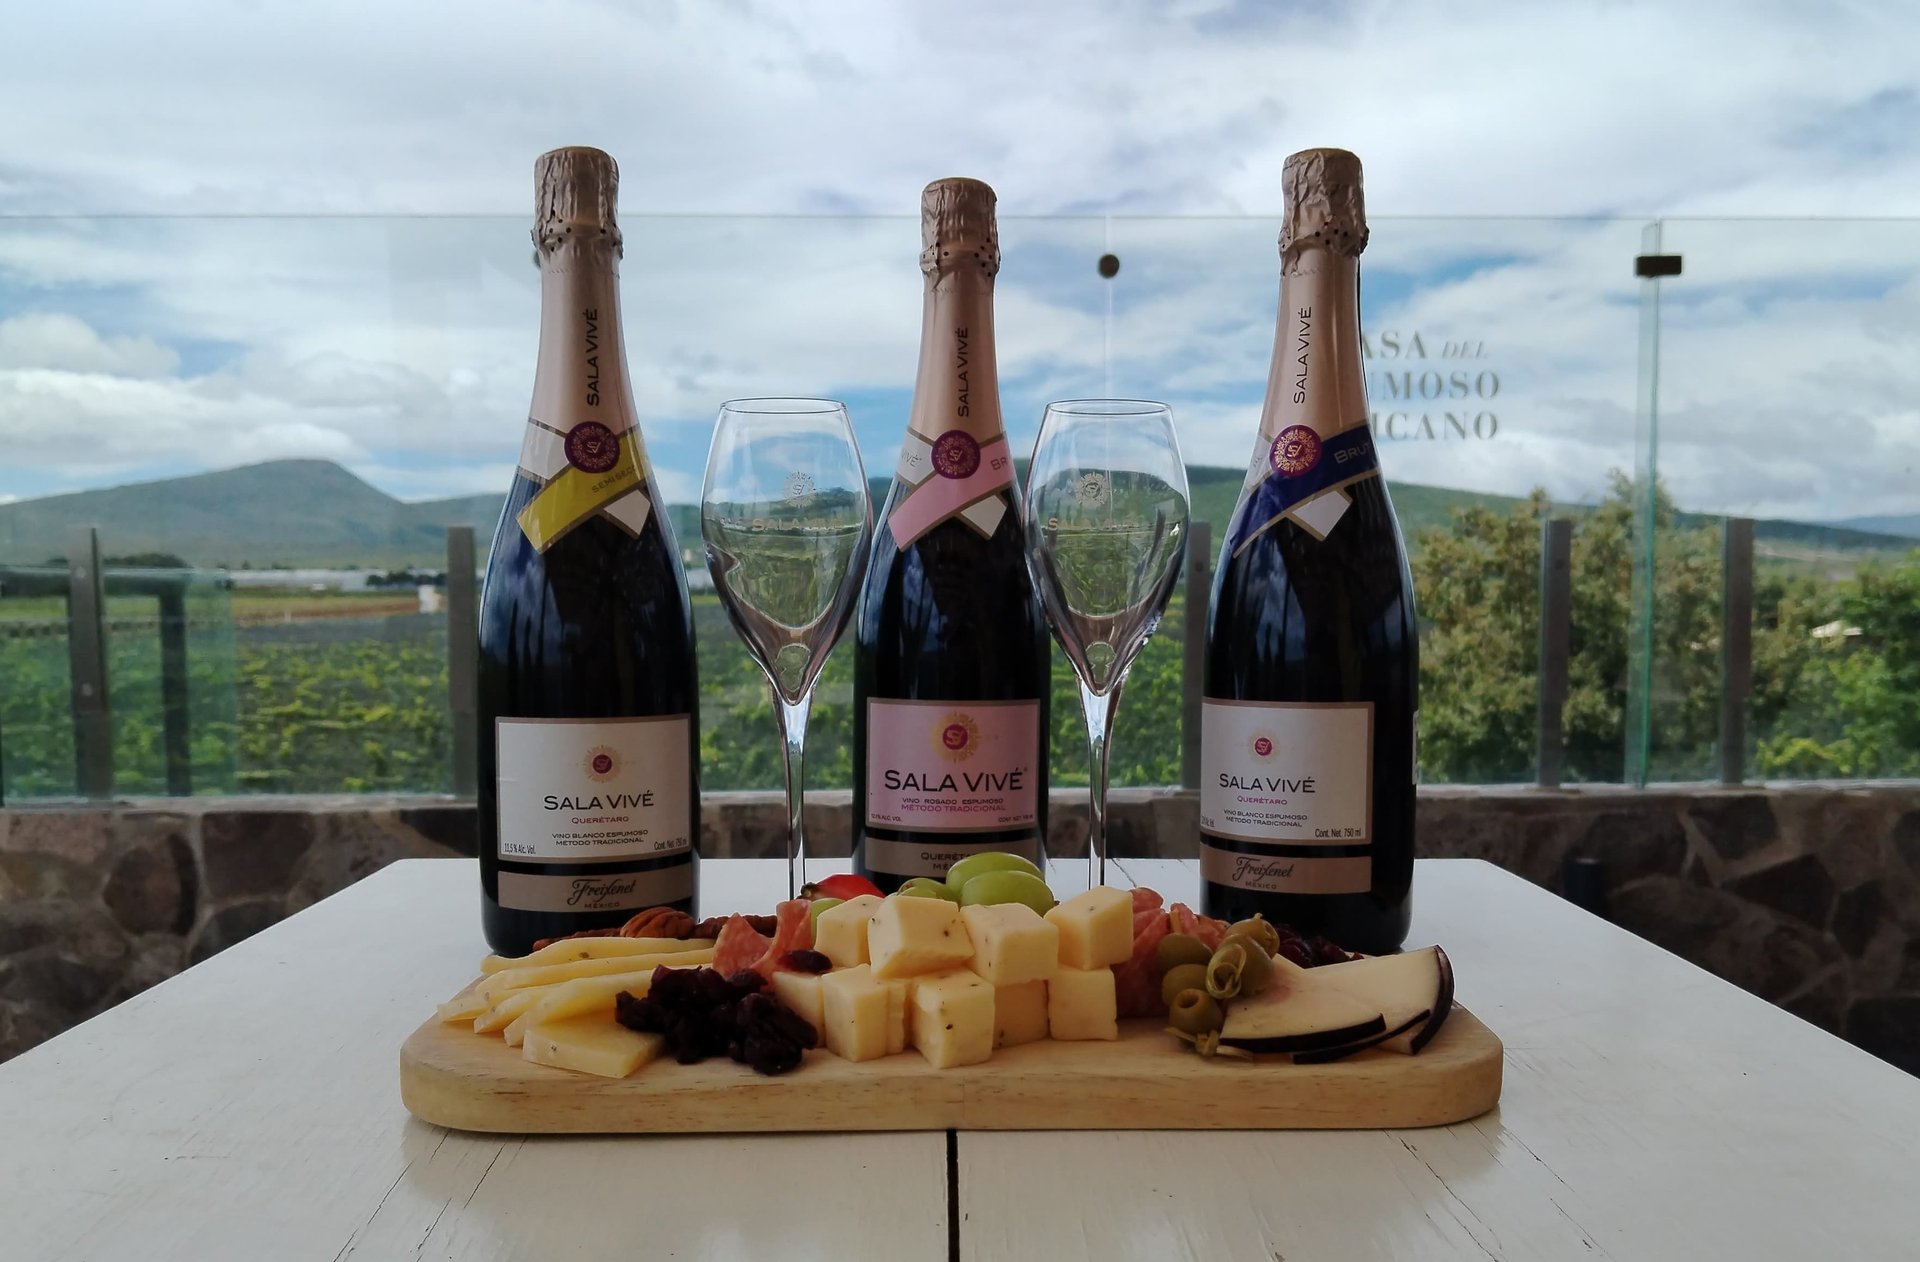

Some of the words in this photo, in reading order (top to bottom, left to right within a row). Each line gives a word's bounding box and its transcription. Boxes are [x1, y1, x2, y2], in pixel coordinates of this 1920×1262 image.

[582, 308, 598, 353] VIVÉ
[1298, 306, 1312, 352] VIVÉ
[955, 327, 968, 369] VIVÉ
[1361, 330, 1426, 360] ASA
[1442, 341, 1489, 359] DEL
[587, 356, 600, 407] SALA
[1293, 353, 1308, 404] SALA
[1370, 370, 1500, 400] MOSO
[957, 371, 969, 417] SALA
[1371, 411, 1498, 441] ICANO
[990, 456, 1008, 471] BR
[884, 769, 958, 792] SALA
[963, 767, 1023, 792] VIVÉ
[1219, 773, 1263, 791] SALA
[1266, 776, 1316, 793] VIVÉ
[543, 795, 604, 811] SALA
[606, 790, 655, 810] VIVÉ
[943, 804, 1006, 812] TRADICIONAL
[1237, 811, 1264, 819] BLANCO
[1265, 813, 1308, 821] ESPUMOSO
[1252, 818, 1303, 828] TRADICIONAL
[592, 837, 644, 846] TRADICIONAL
[606, 829, 649, 838] ESPUMOSO
[1343, 828, 1354, 838] 750
[1355, 828, 1361, 837] ml
[1232, 856, 1294, 882] Freixenet
[567, 878, 637, 905] Freixenet
